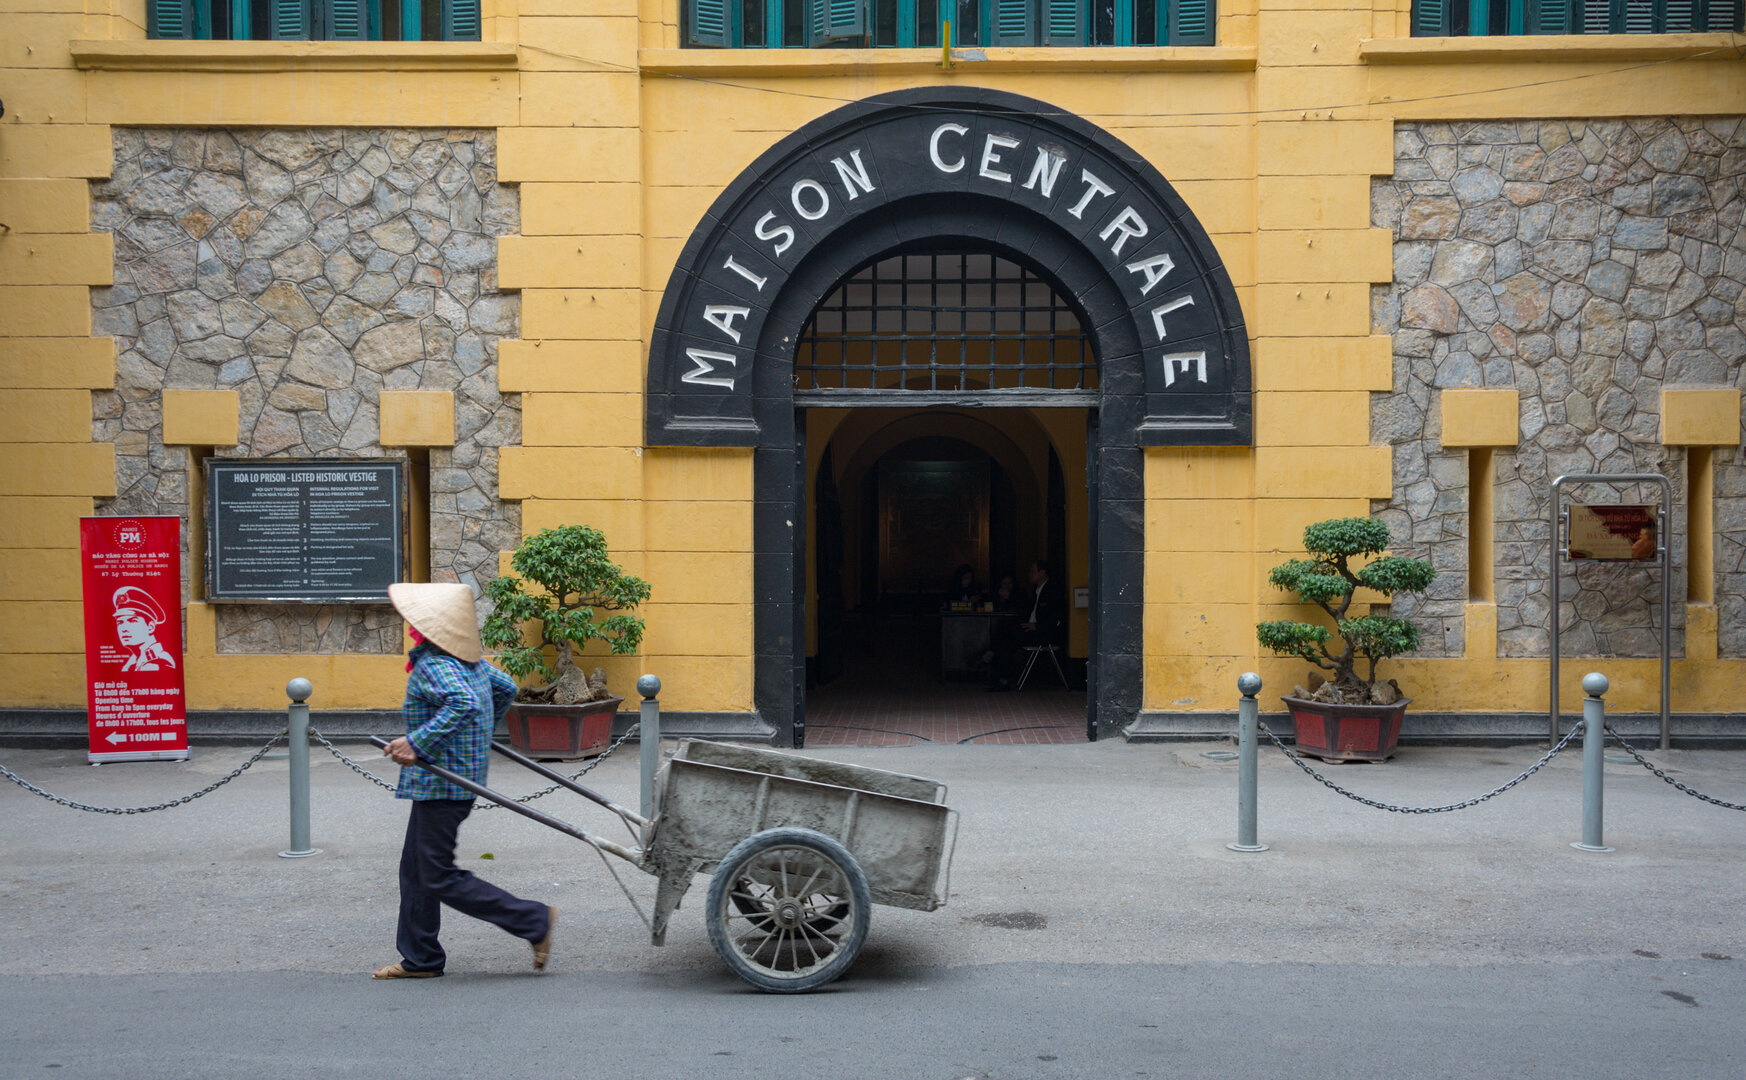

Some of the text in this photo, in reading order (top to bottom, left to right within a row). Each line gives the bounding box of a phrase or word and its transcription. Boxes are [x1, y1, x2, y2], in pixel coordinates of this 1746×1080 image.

[681, 123, 1207, 390] MAISON CENTRALE
[234, 473, 249, 483] HOA
[250, 473, 259, 483] LO
[260, 473, 286, 483] PRISON
[291, 472, 315, 482] LISTED
[316, 472, 348, 482] HISTORIC
[348, 472, 377, 482] VESTIGE
[120, 532, 141, 543] PM
[128, 732, 160, 742] 100M
